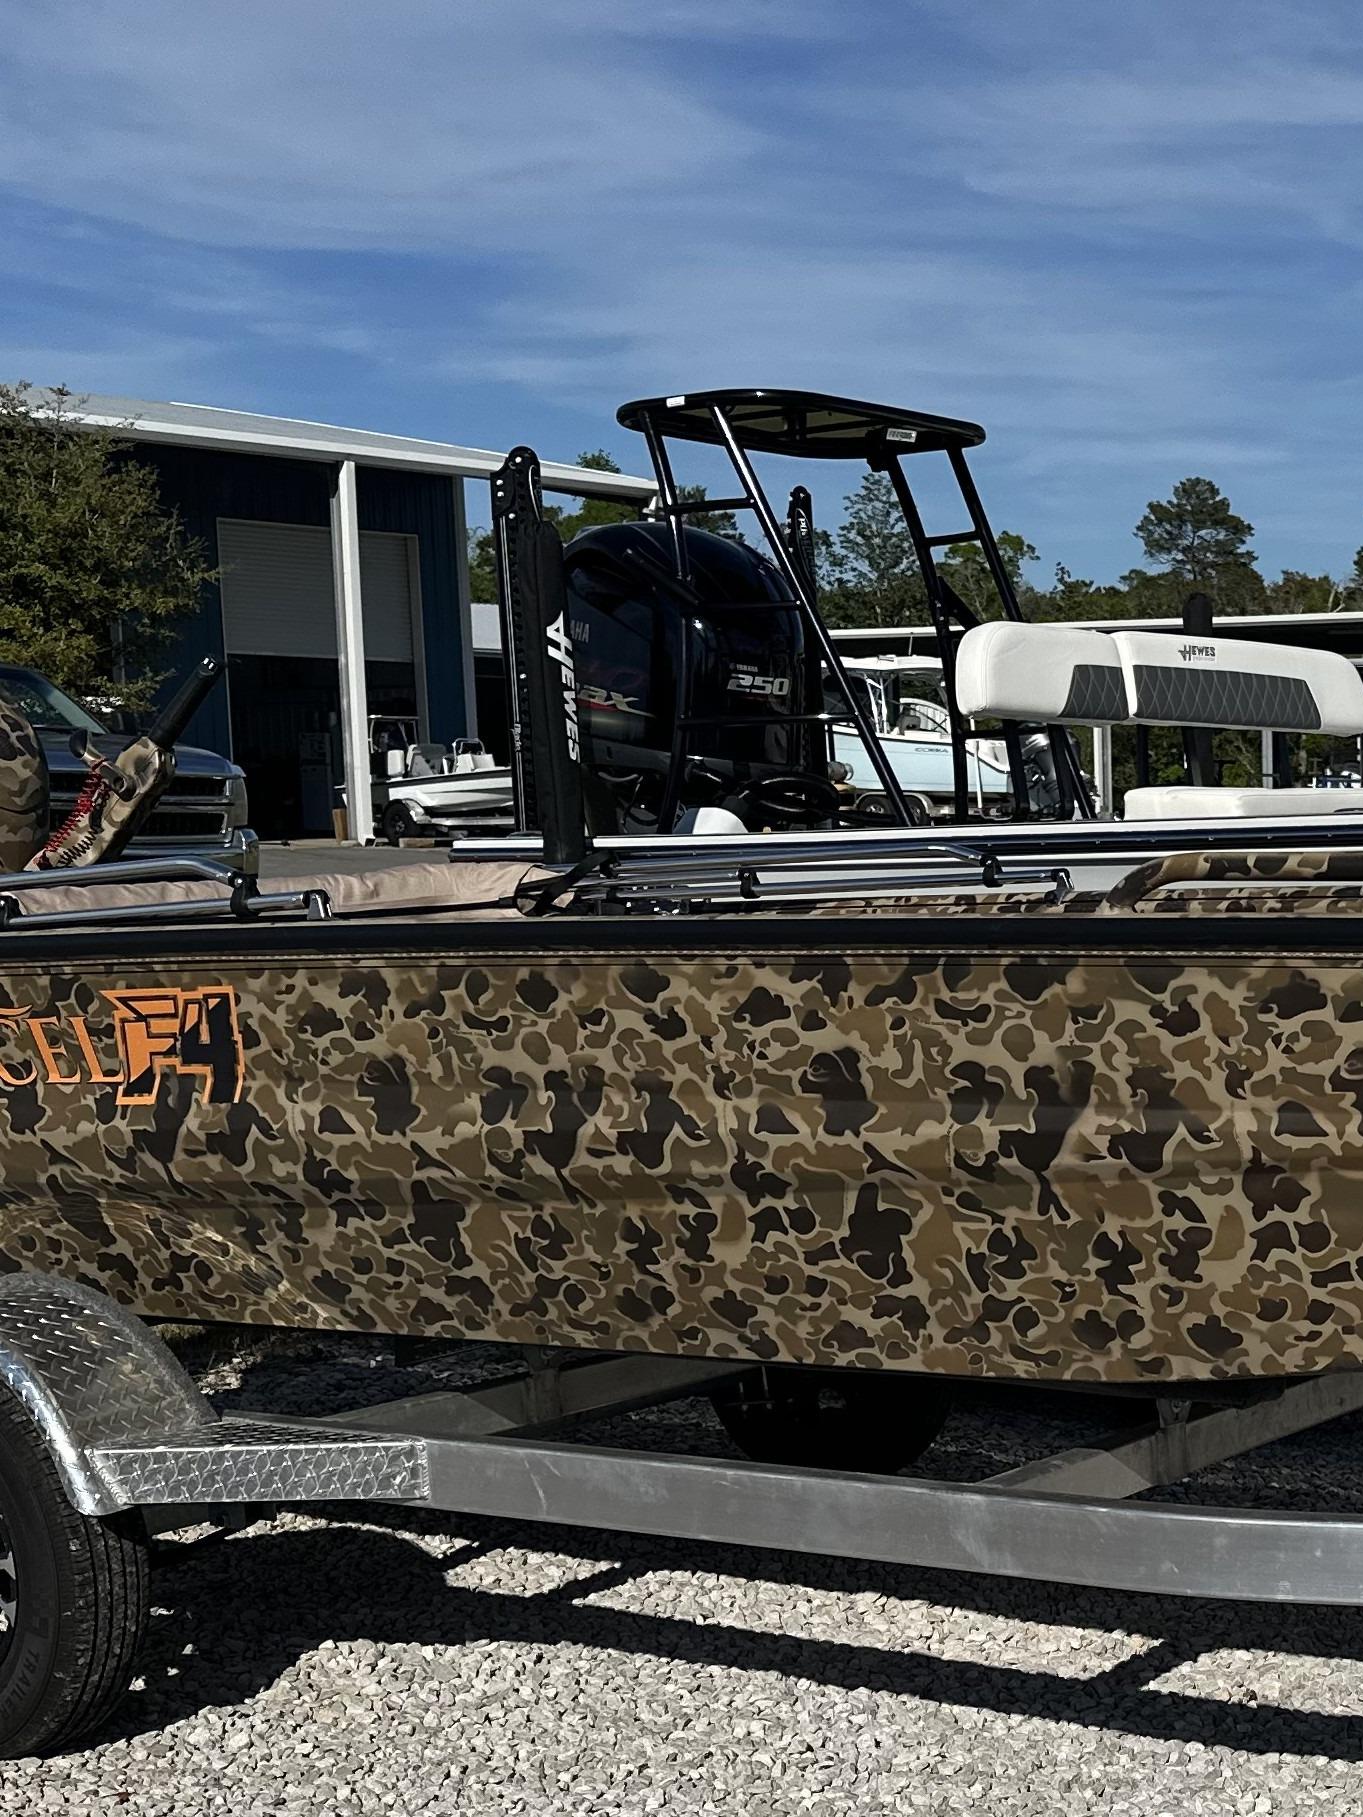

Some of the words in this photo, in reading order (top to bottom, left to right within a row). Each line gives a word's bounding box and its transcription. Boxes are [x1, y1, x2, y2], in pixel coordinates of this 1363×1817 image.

[1178, 645, 1215, 661] HEWES
[546, 610, 581, 764] HEWES
[727, 673, 790, 695] 250
